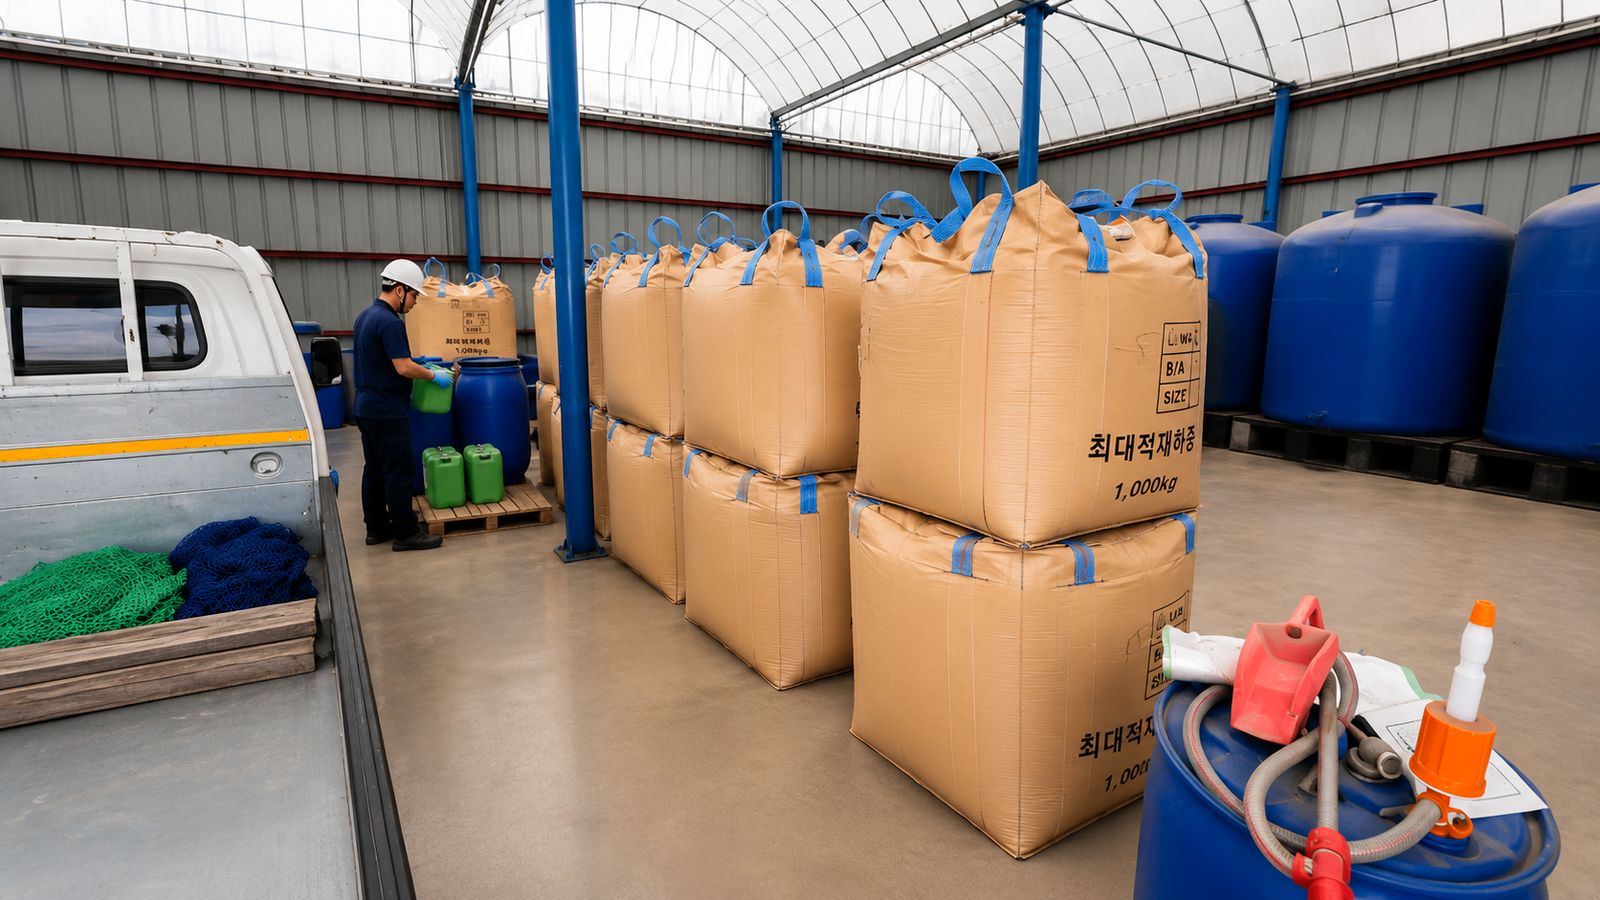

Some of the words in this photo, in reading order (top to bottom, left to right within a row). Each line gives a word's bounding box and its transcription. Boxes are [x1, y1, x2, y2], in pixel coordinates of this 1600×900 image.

[1166, 361, 1185, 377] B/A
[1163, 388, 1187, 405] SIZE
[1088, 424, 1196, 463] 최대적재하중
[1114, 475, 1178, 502] 1,000kg
